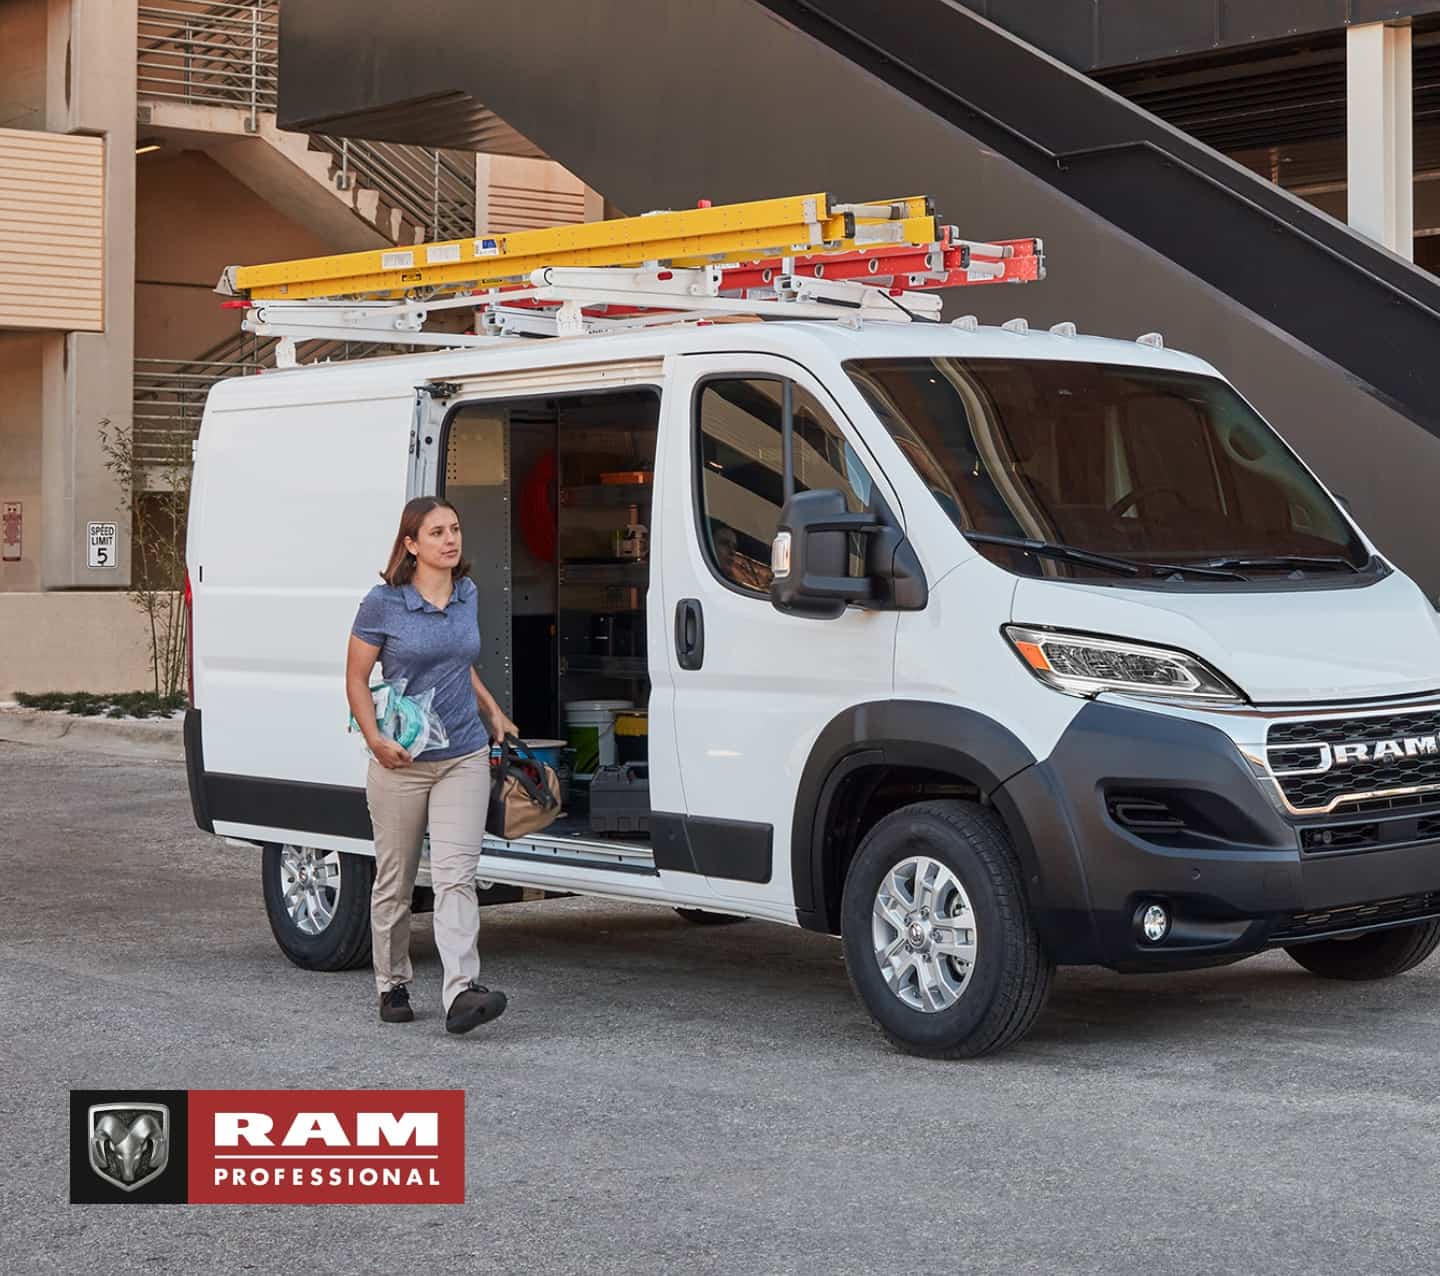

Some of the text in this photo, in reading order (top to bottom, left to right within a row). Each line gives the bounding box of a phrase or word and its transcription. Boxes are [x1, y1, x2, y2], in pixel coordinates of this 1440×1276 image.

[91, 526, 114, 536] SPEED
[91, 537, 112, 545] LIMIT
[97, 548, 108, 564] 5
[1333, 736, 1438, 763] RAM
